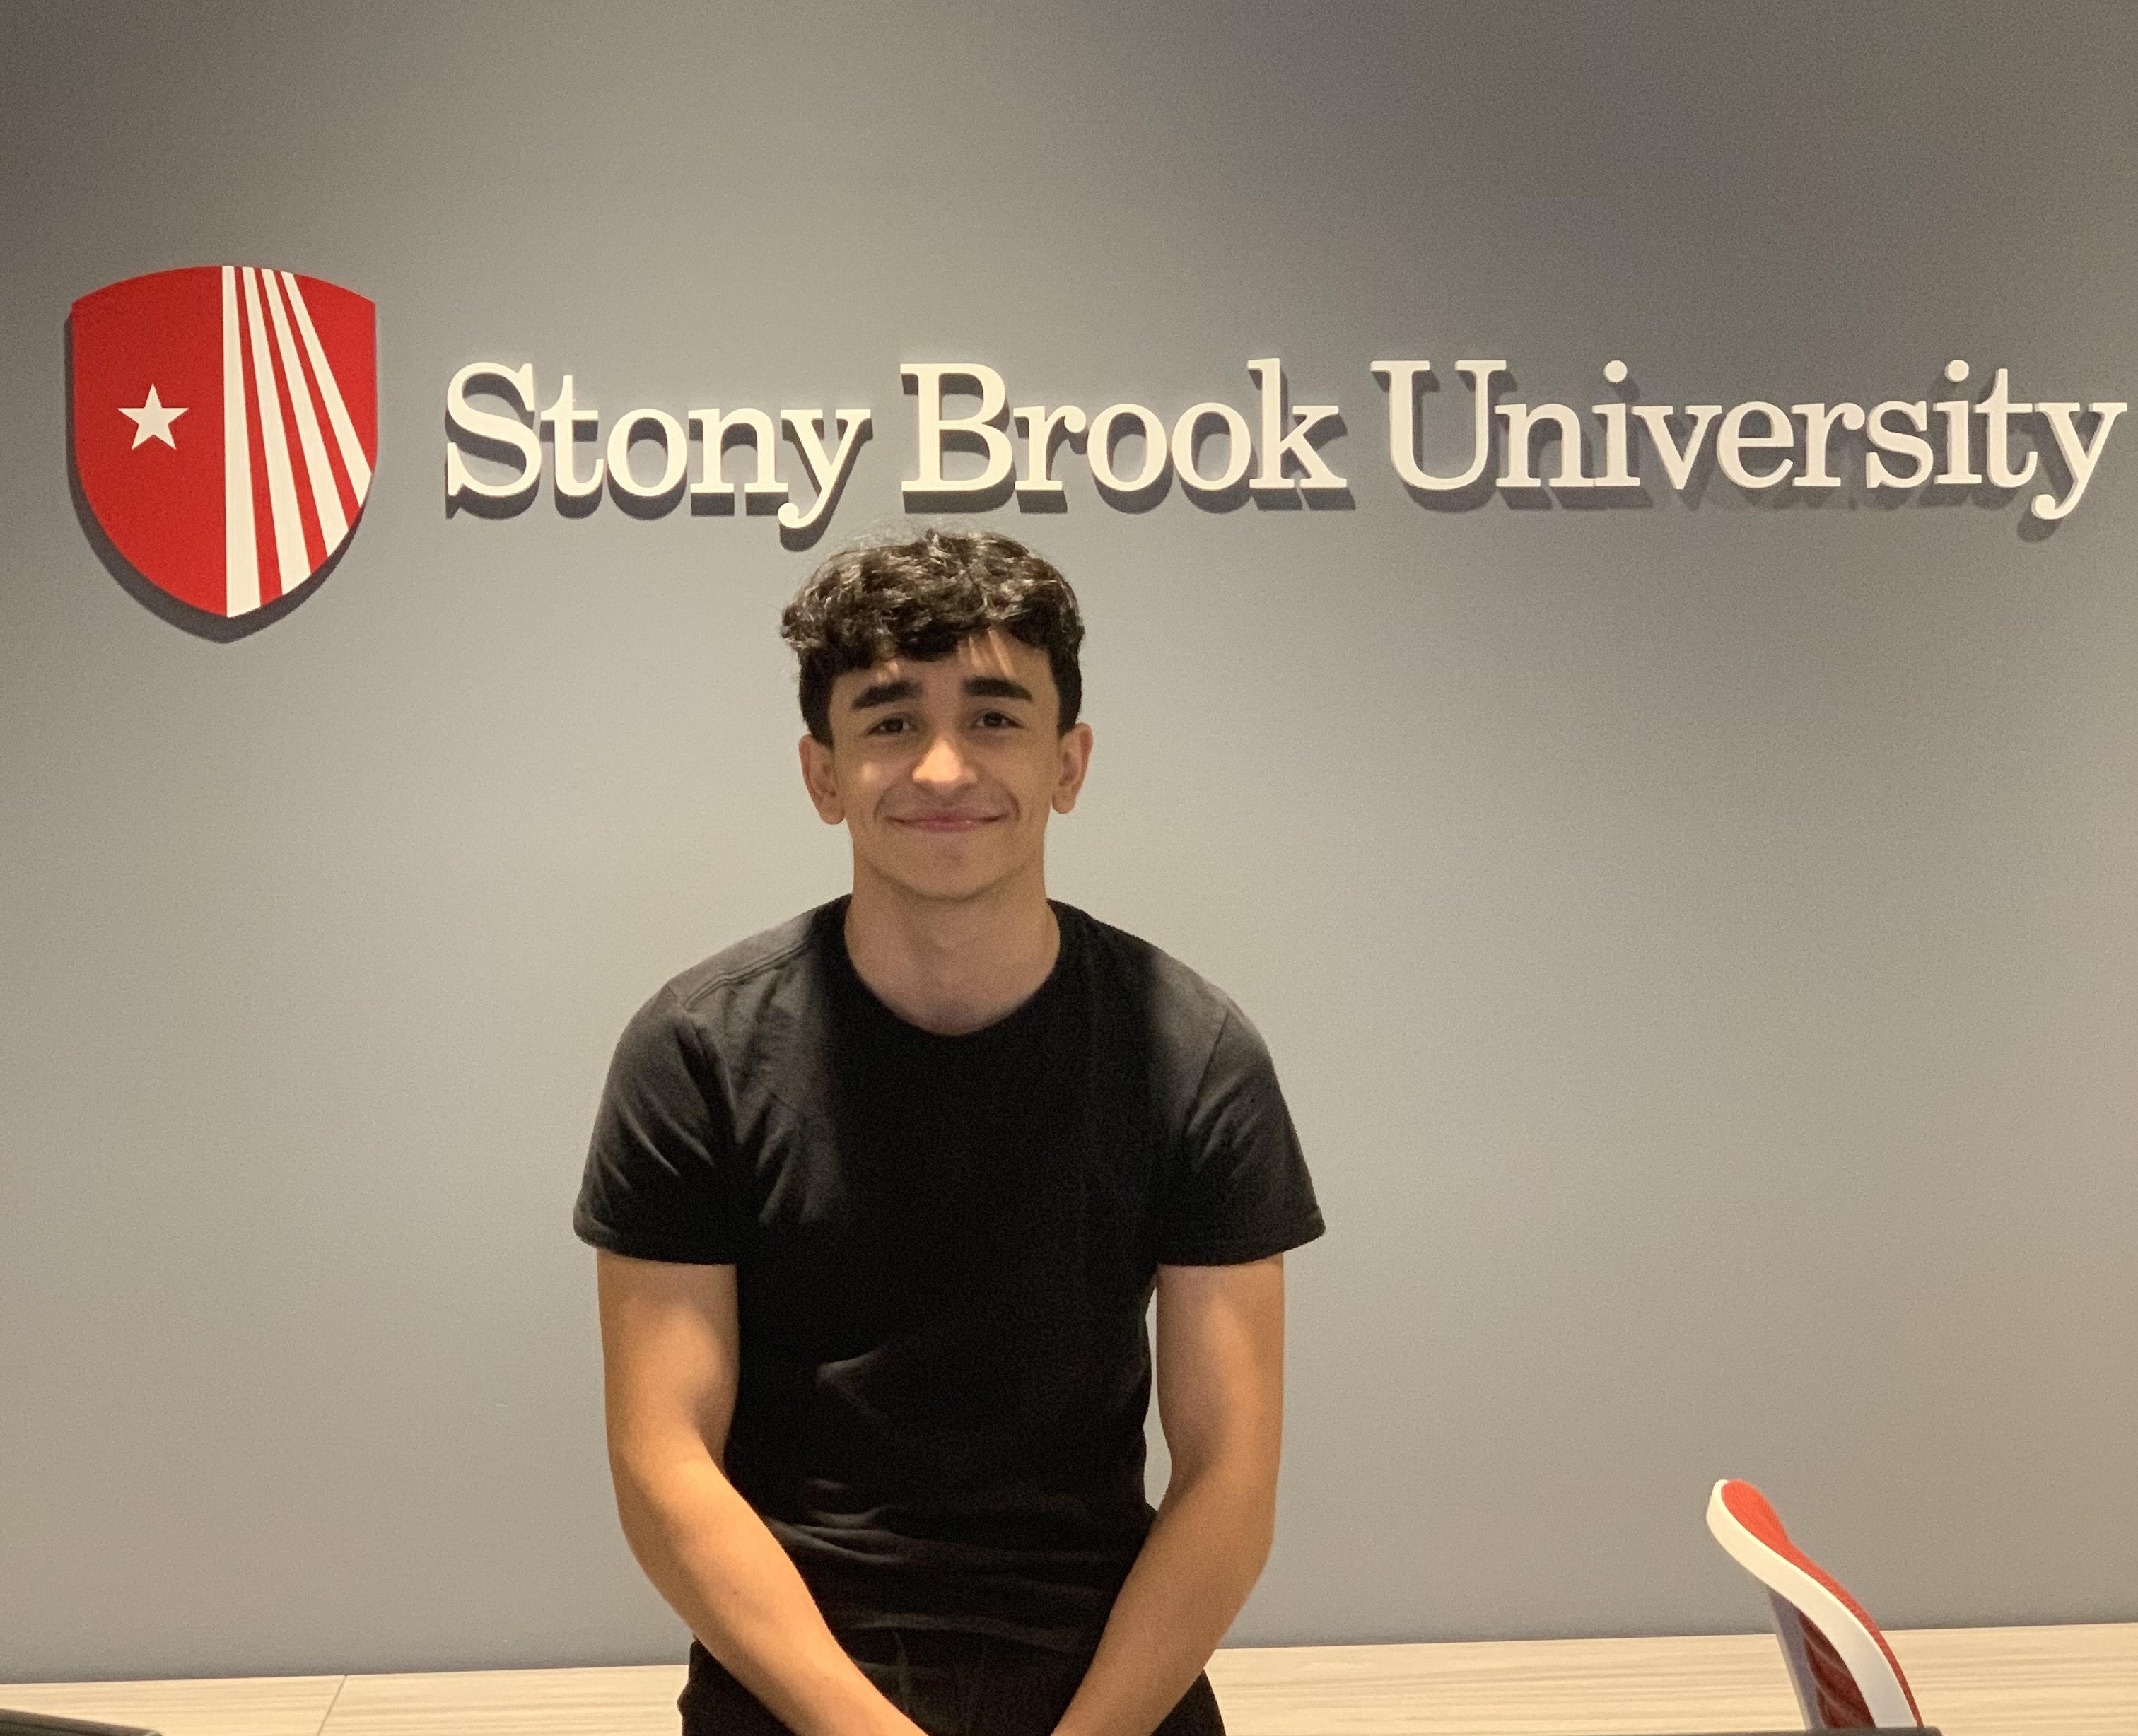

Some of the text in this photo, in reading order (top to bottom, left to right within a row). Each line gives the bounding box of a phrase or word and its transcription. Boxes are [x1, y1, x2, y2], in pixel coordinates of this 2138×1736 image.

[446, 357, 2129, 529] Stony Brook University
